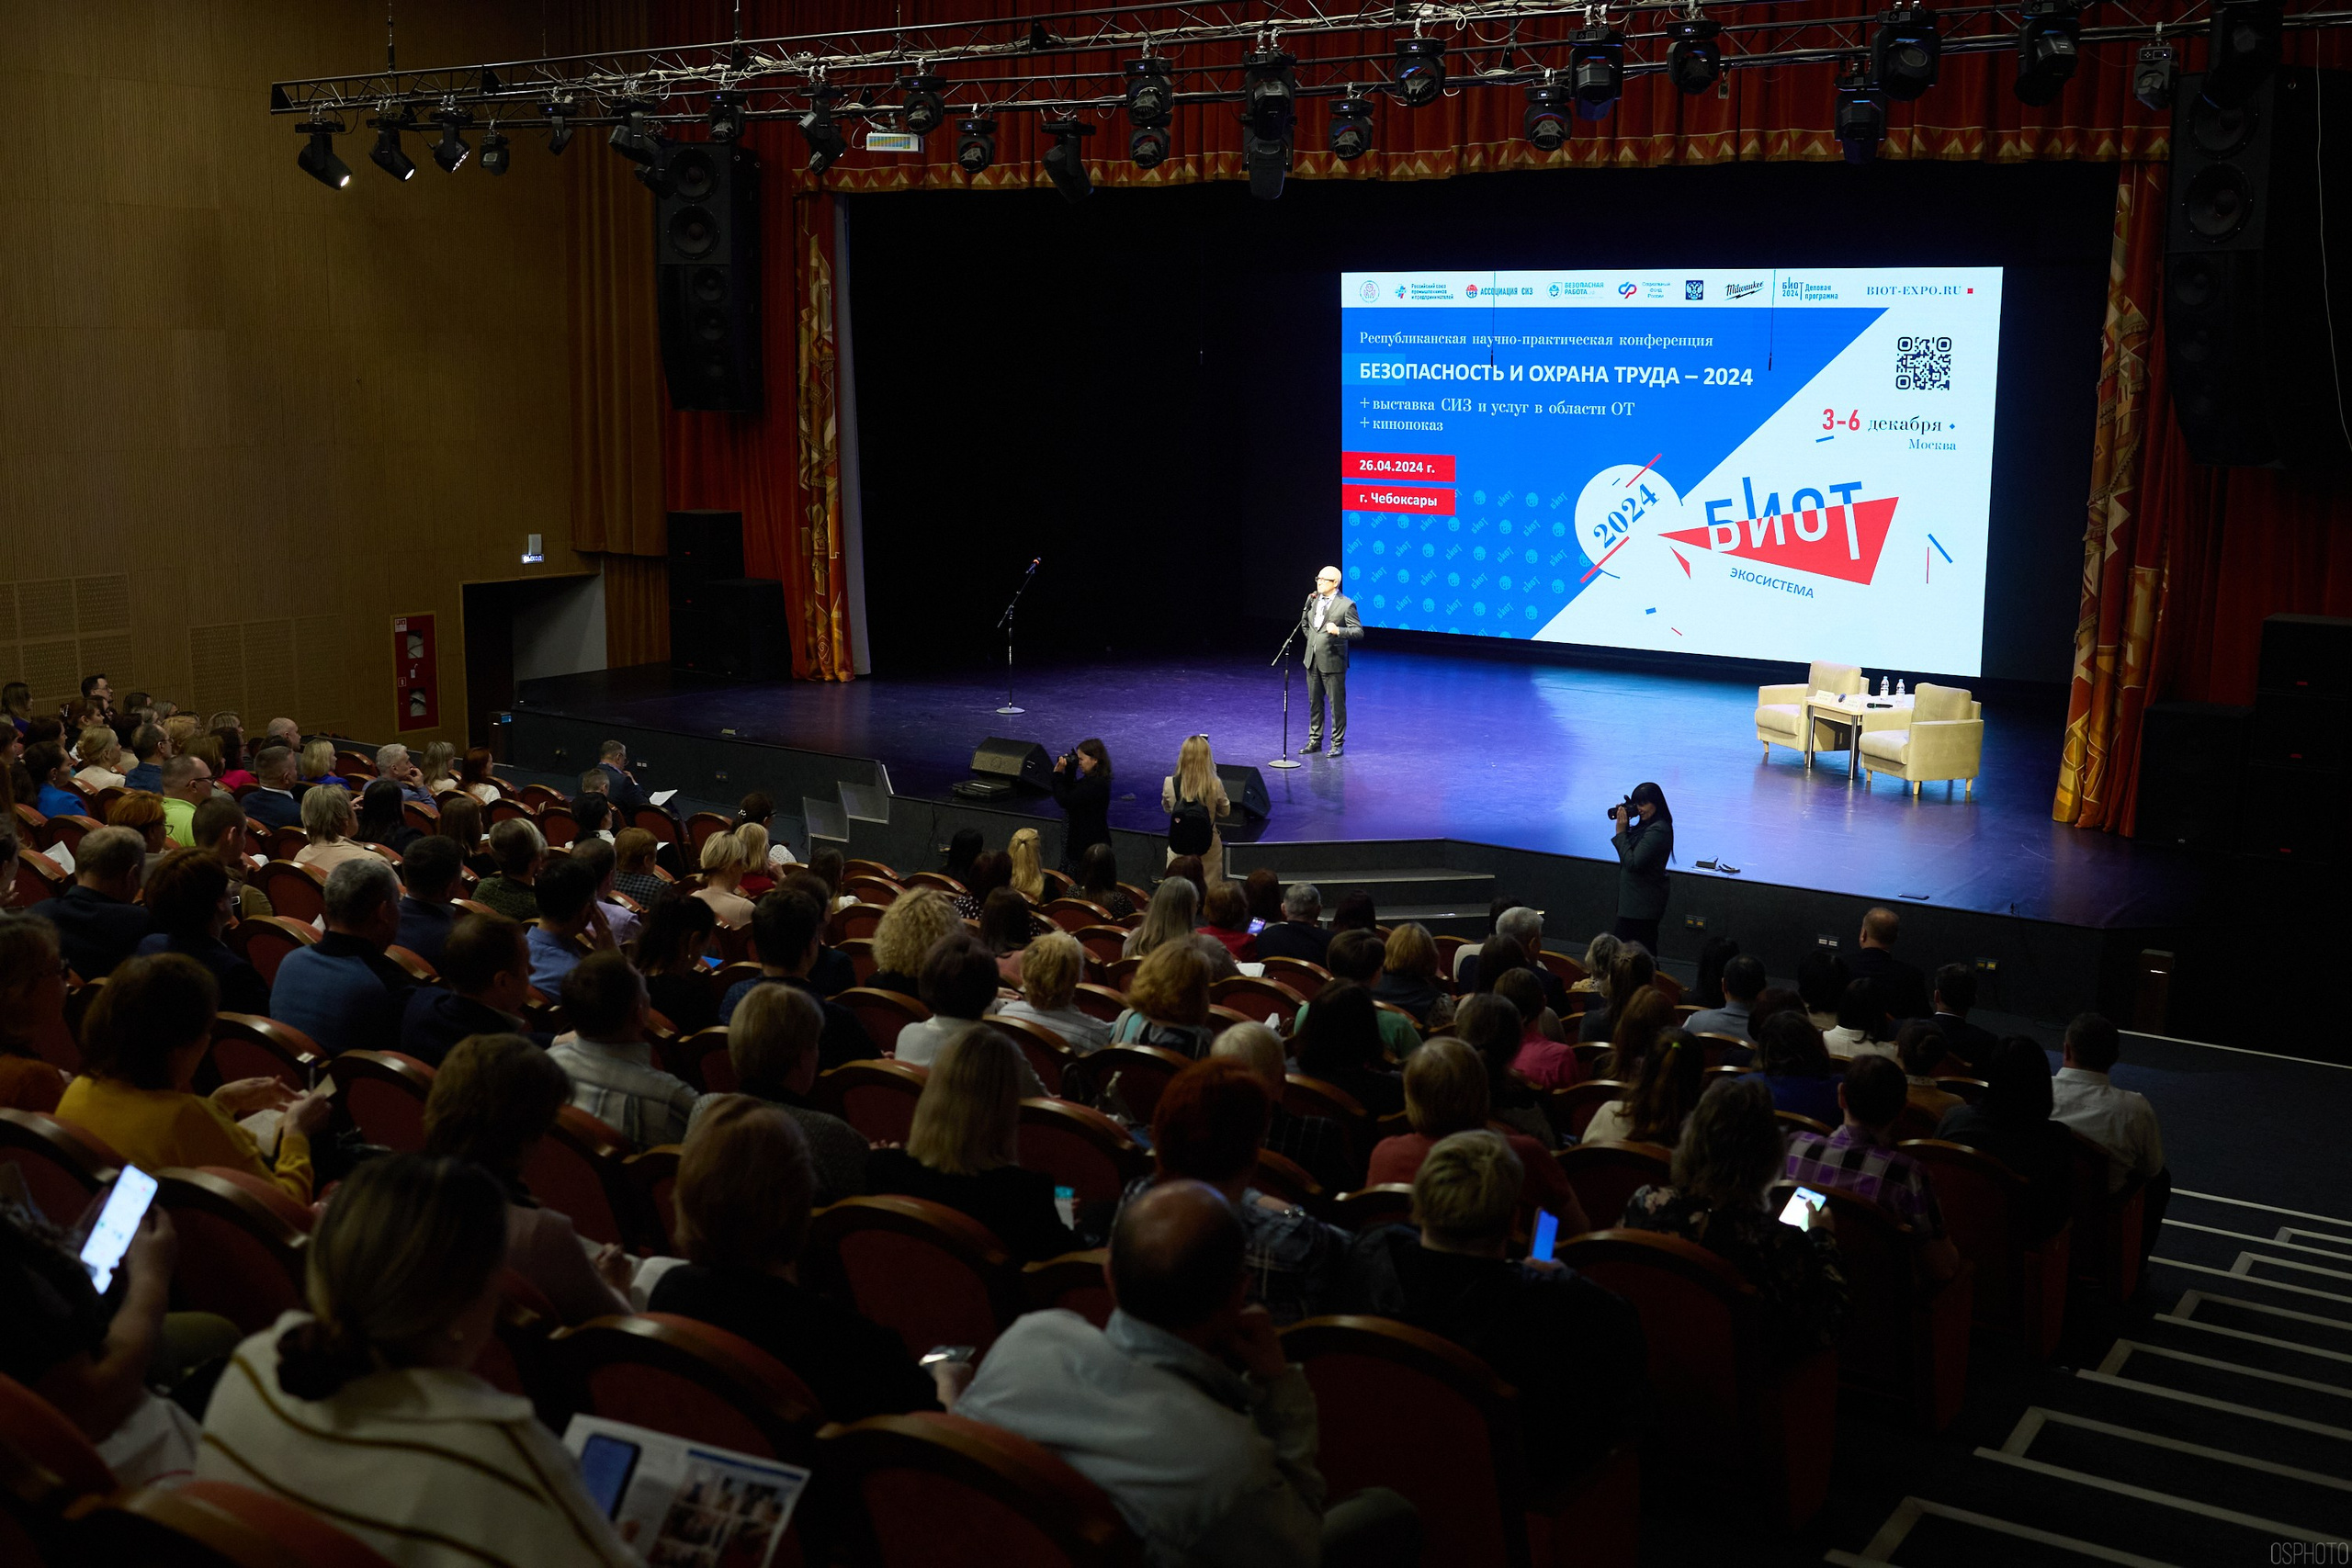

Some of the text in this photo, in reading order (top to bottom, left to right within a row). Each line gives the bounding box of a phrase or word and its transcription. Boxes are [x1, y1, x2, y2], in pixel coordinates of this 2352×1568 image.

[1480, 287, 1533, 297] АССОЦИАЦИЯ СИЗ
[1724, 280, 1764, 296] Milwaukee
[1868, 286, 1961, 295] BIOT-EXPO.RU
[1361, 332, 1713, 349] Республиканская научно-практическая конференция
[1360, 362, 1504, 381] БЕЗОПАСНОСТЬ
[1510, 365, 1522, 381] И
[1529, 366, 1609, 382] ОХРАНА
[1614, 367, 1679, 388] ТРУДА
[1703, 367, 1753, 385] 2024
[1442, 398, 1471, 412] СИЗ
[1478, 403, 1487, 412] и
[1491, 403, 1529, 416] услуг
[1535, 404, 1543, 413] в
[1549, 400, 1606, 414] области
[1611, 401, 1635, 415] ОТ
[1868, 415, 1940, 434] декабря
[1909, 439, 1956, 450] Москва
[1360, 459, 1435, 473] 26.04.2024 г.
[1360, 492, 1437, 508] г. Чебоксары
[1593, 483, 1660, 549] 2024
[1704, 476, 1862, 560] БИОТ
[1729, 567, 1815, 599] ЭКОСИСТЕМА
